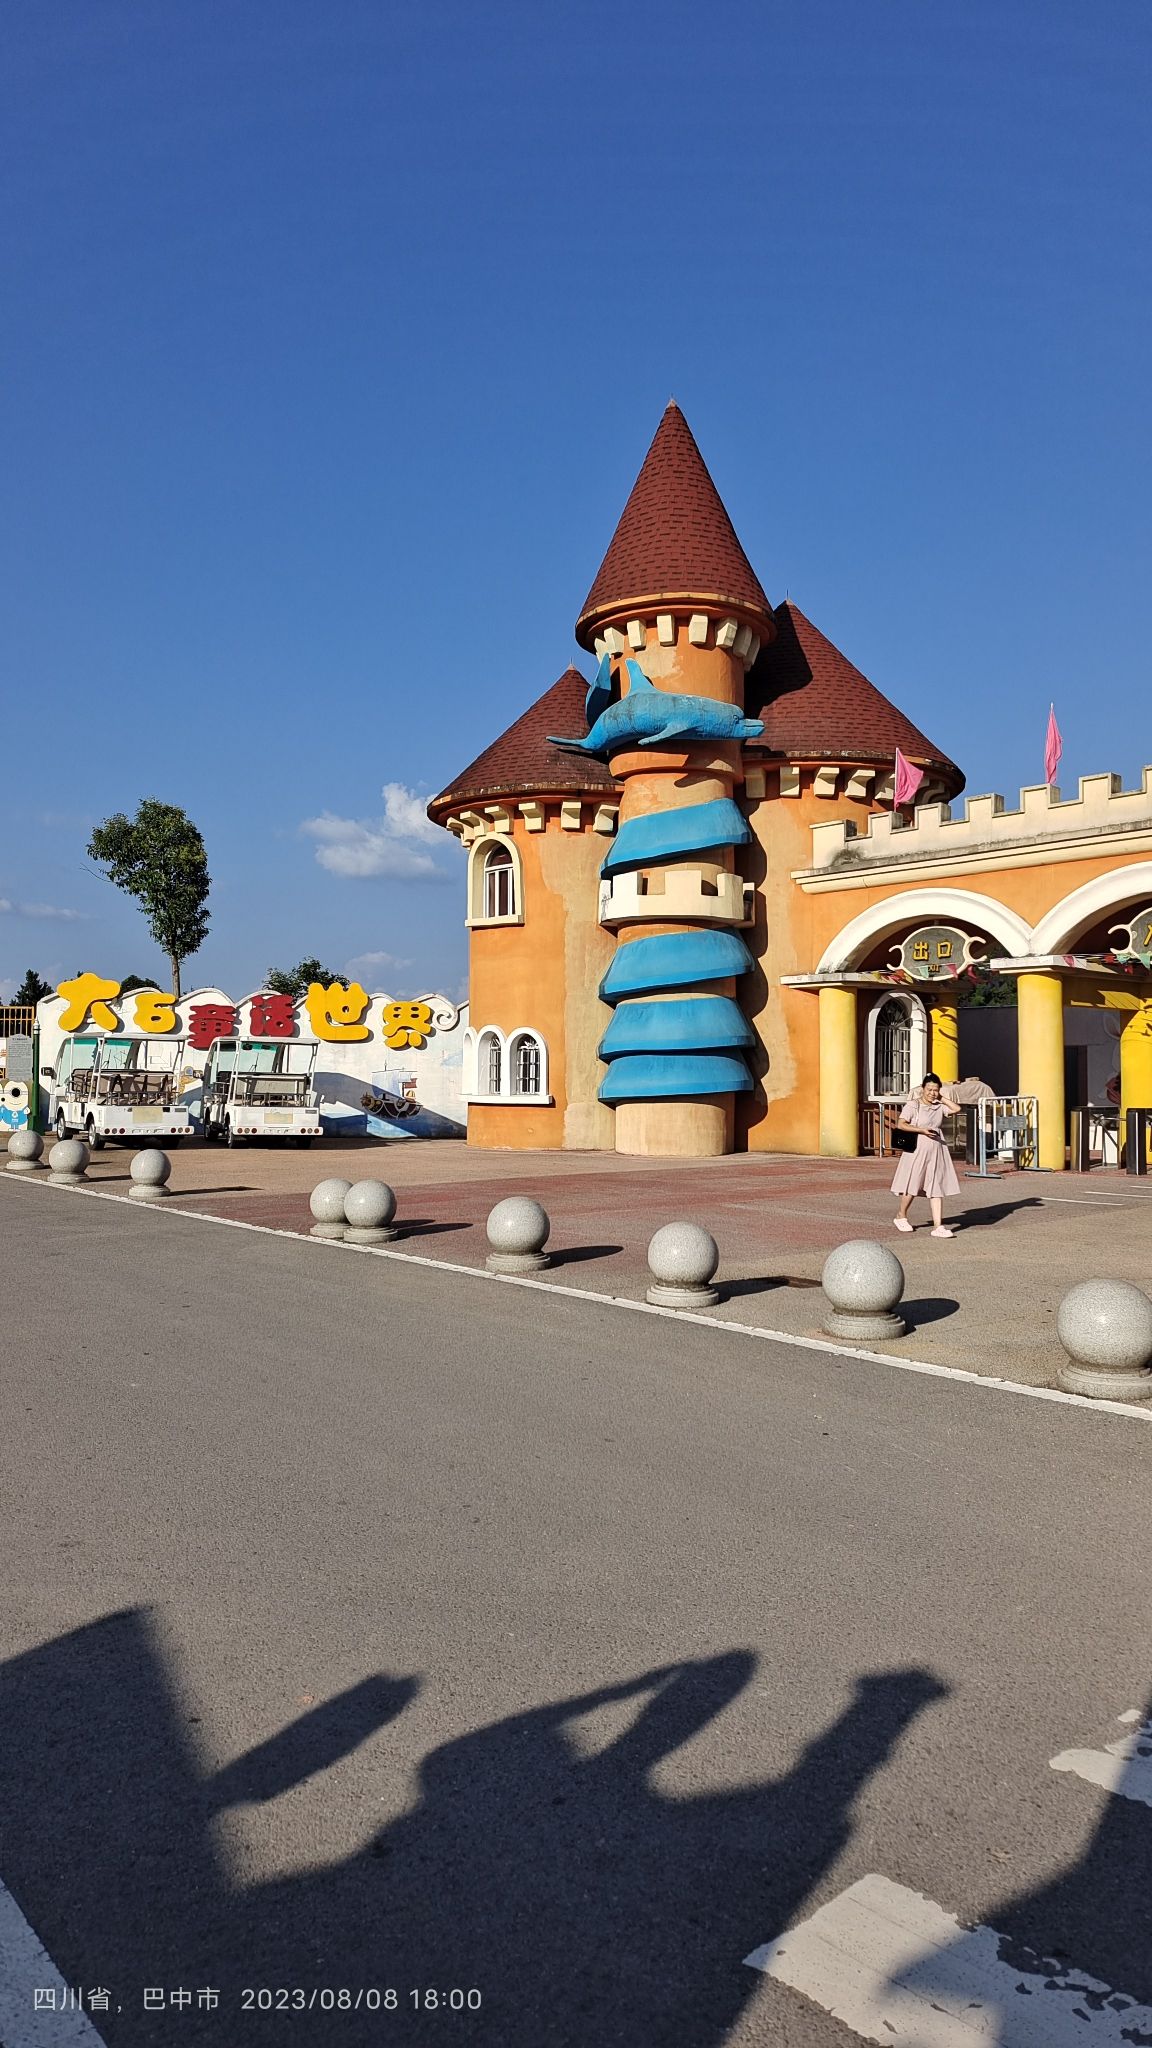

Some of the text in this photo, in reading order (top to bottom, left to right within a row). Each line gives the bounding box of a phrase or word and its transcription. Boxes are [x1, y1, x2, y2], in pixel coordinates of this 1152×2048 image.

[912, 940, 953, 960] 出口
[56, 972, 433, 1050] 大石童话世界
